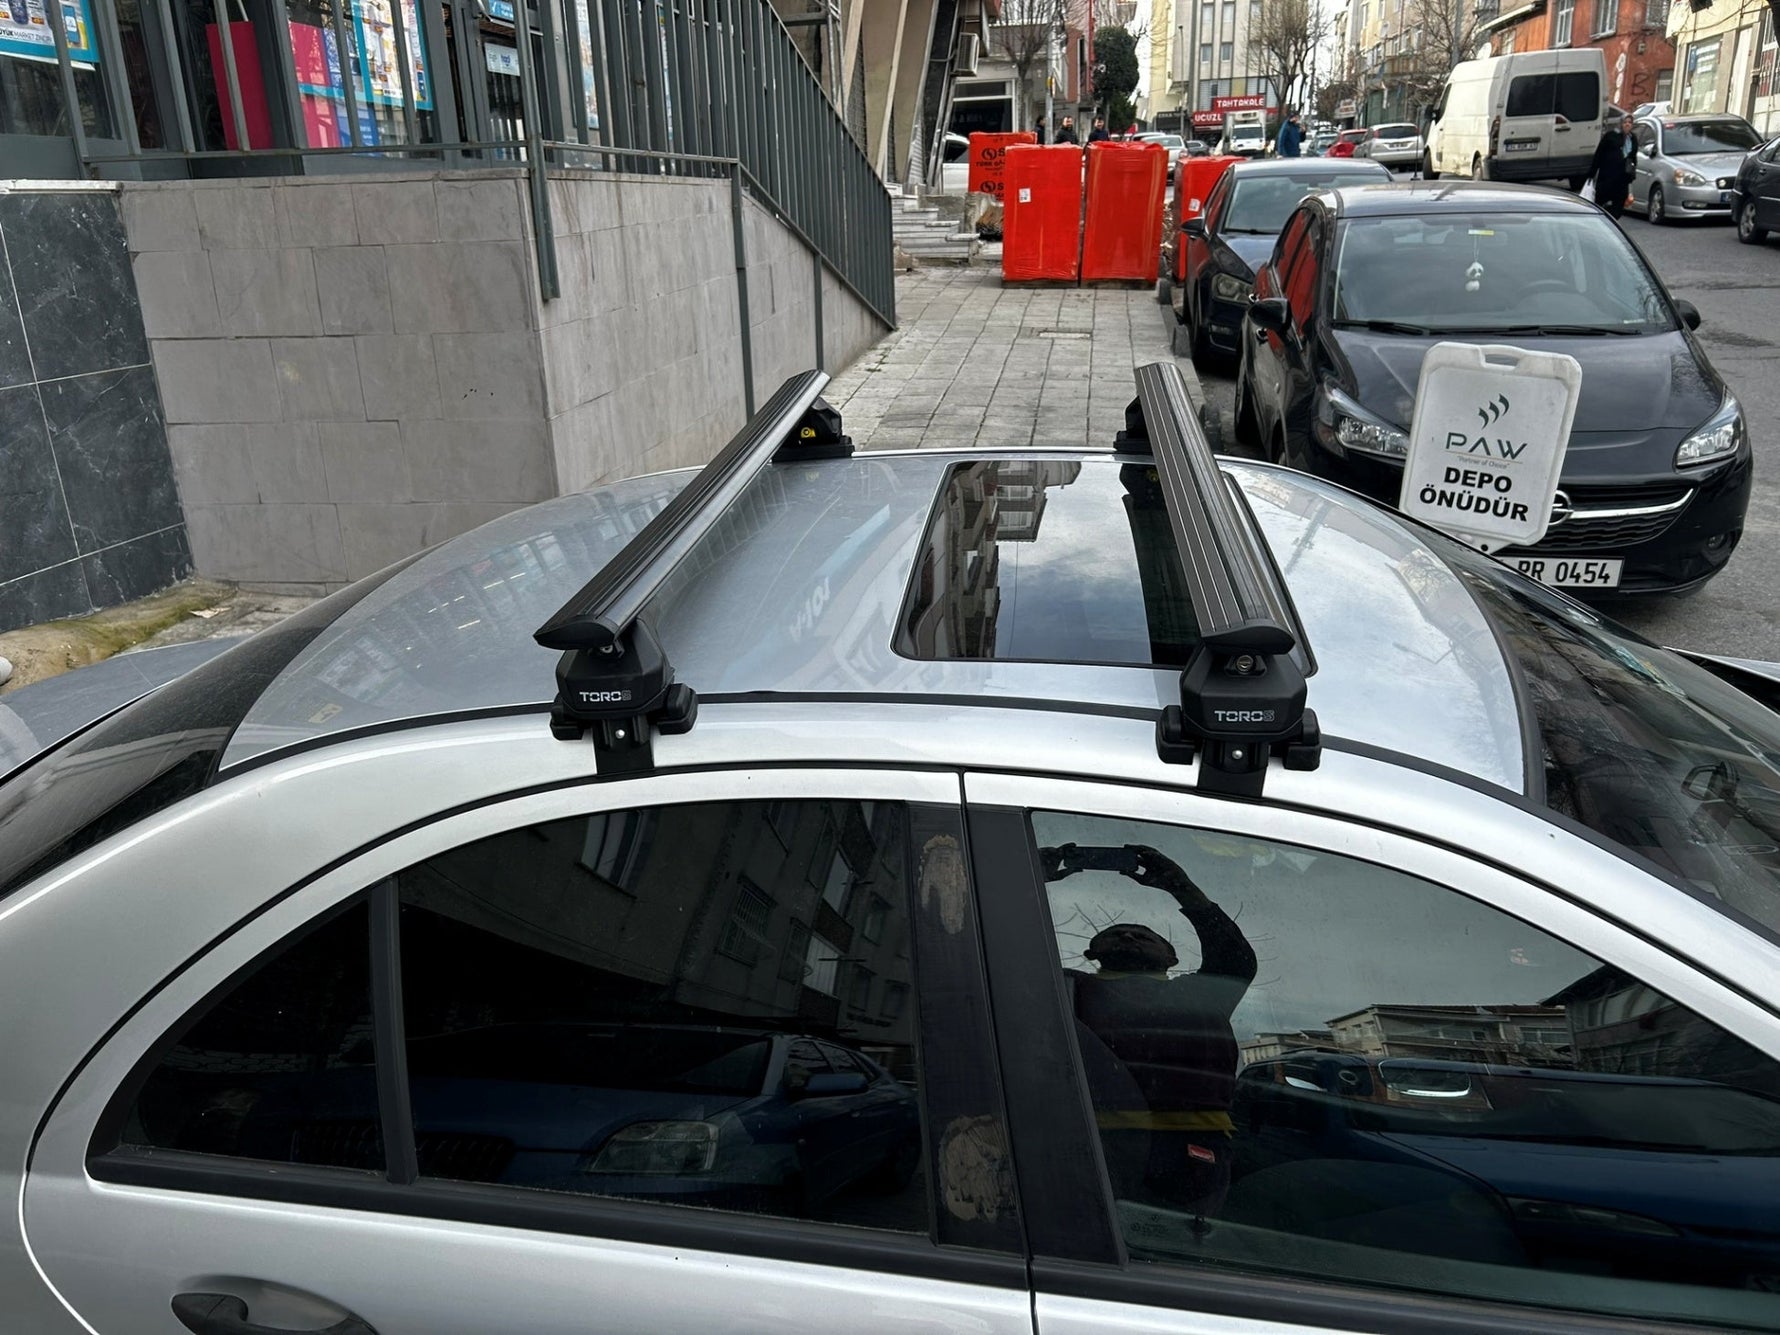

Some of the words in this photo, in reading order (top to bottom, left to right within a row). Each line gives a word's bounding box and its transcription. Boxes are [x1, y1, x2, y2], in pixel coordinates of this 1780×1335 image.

[1216, 97, 1265, 108] TAHTAKALE
[1194, 113, 1222, 122] UCUZL
[1446, 432, 1528, 460] PAW
[1443, 466, 1512, 493] DEPO
[1419, 483, 1529, 522] ÖNÜDÜR
[1555, 561, 1611, 584] 0454
